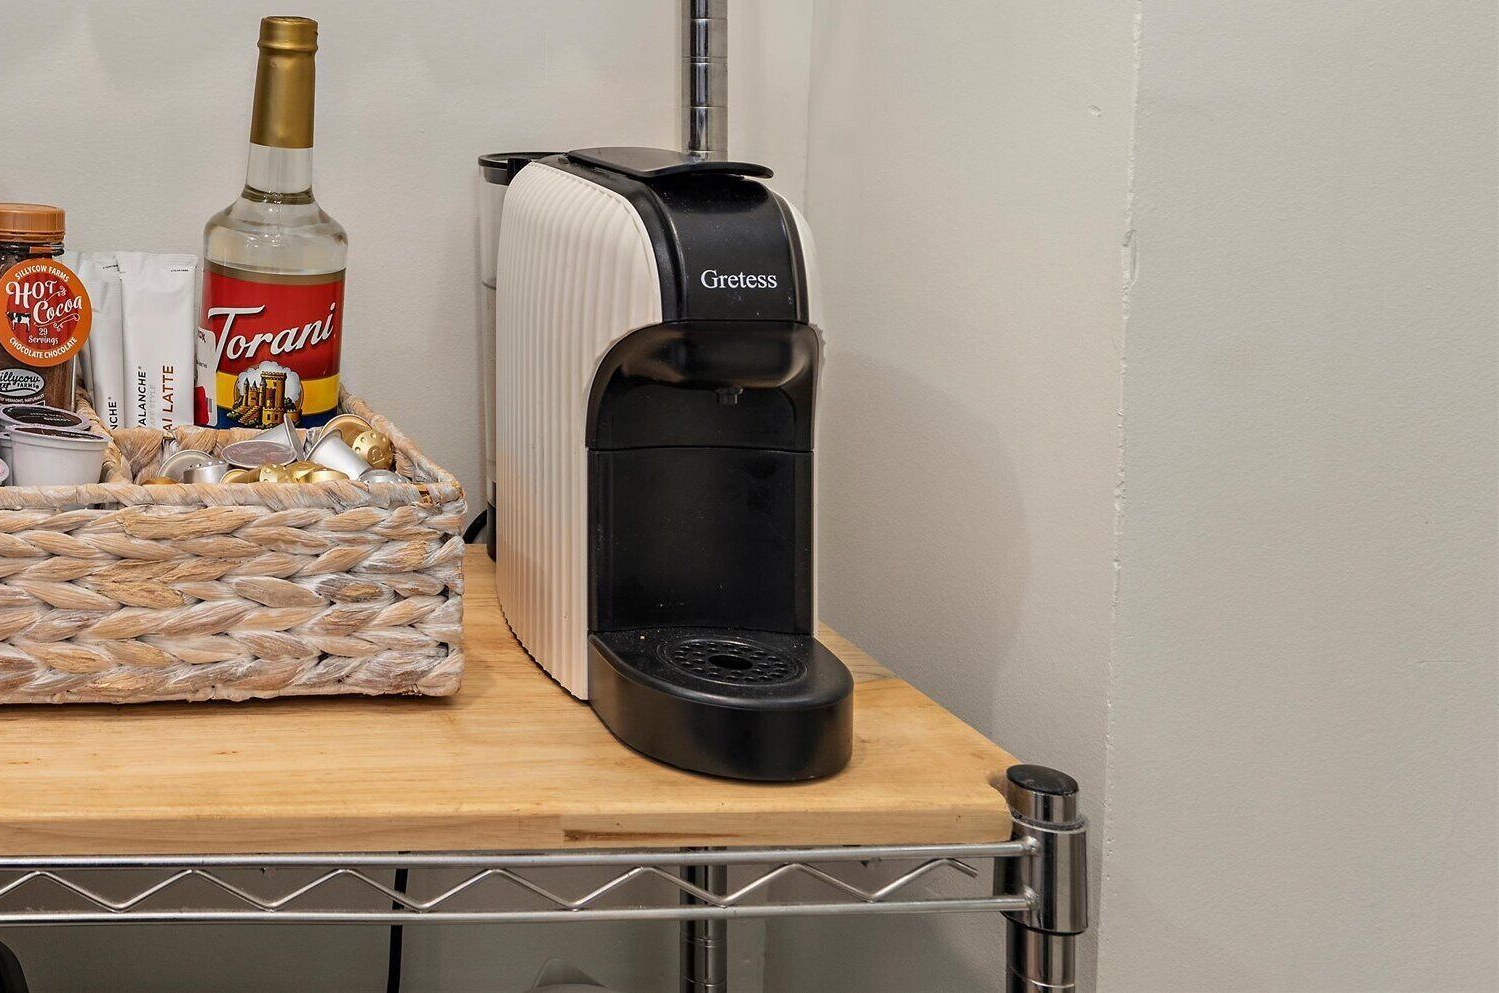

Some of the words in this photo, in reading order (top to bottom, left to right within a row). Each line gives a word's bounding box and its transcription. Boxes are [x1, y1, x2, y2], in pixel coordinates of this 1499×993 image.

[14, 264, 47, 280] SILLYCOW
[48, 266, 70, 282] FARMS
[700, 269, 778, 289] Gretess
[5, 280, 58, 309] HOT
[33, 296, 83, 325] Cocoa
[28, 335, 59, 346] Servings
[38, 328, 48, 336] 29
[207, 302, 337, 372] Torani
[9, 337, 43, 359] CHOCOLATE
[44, 336, 78, 359] CHOCOLATE
[137, 371, 147, 428] ALANCHE
[162, 365, 174, 413] LATTE
[107, 401, 118, 430] NCHE
[162, 418, 173, 431] AI
